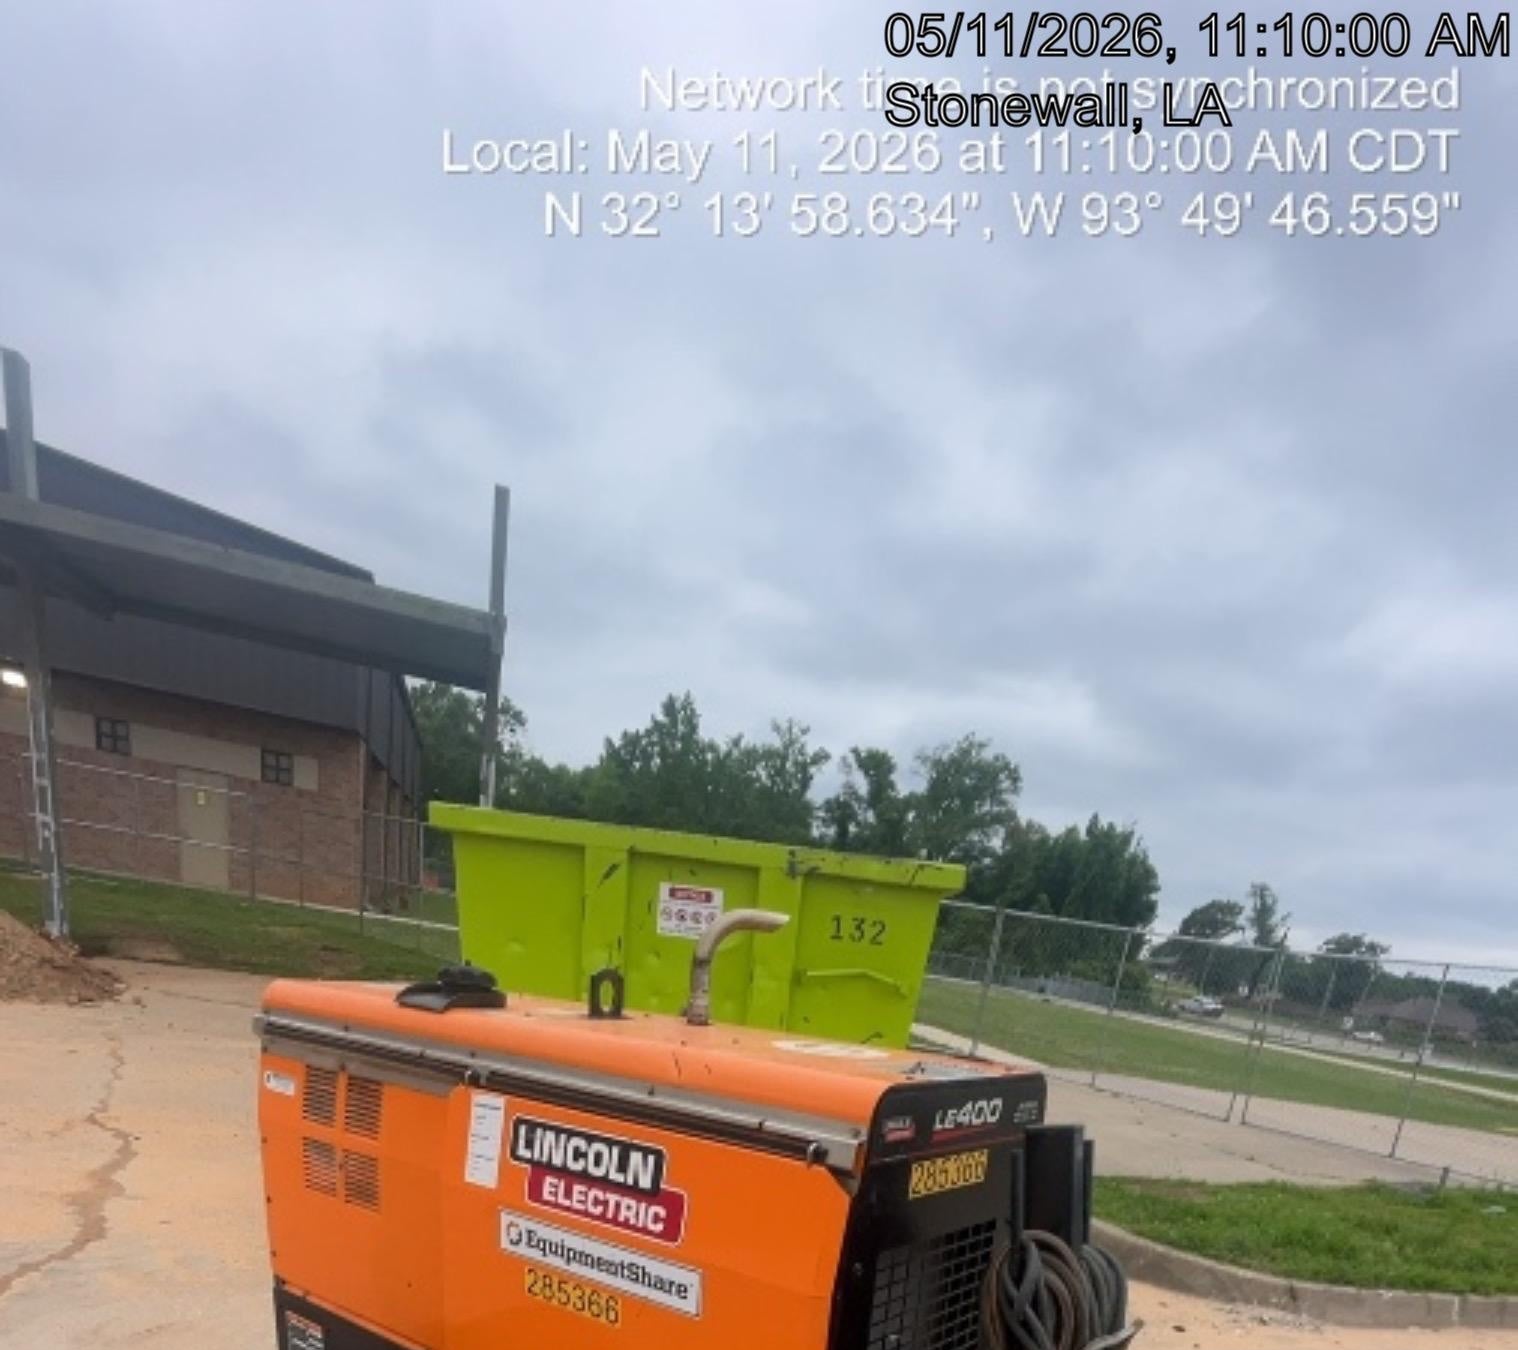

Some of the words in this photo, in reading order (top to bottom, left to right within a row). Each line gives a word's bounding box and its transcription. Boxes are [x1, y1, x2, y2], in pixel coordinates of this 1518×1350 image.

[830, 914, 887, 946] 132
[934, 1097, 1003, 1130] LE400
[516, 1124, 656, 1189] LINCOLN
[542, 1176, 667, 1233] ELECTRIC
[524, 1229, 690, 1300] EquipmentShare
[526, 1268, 620, 1325] 285366
